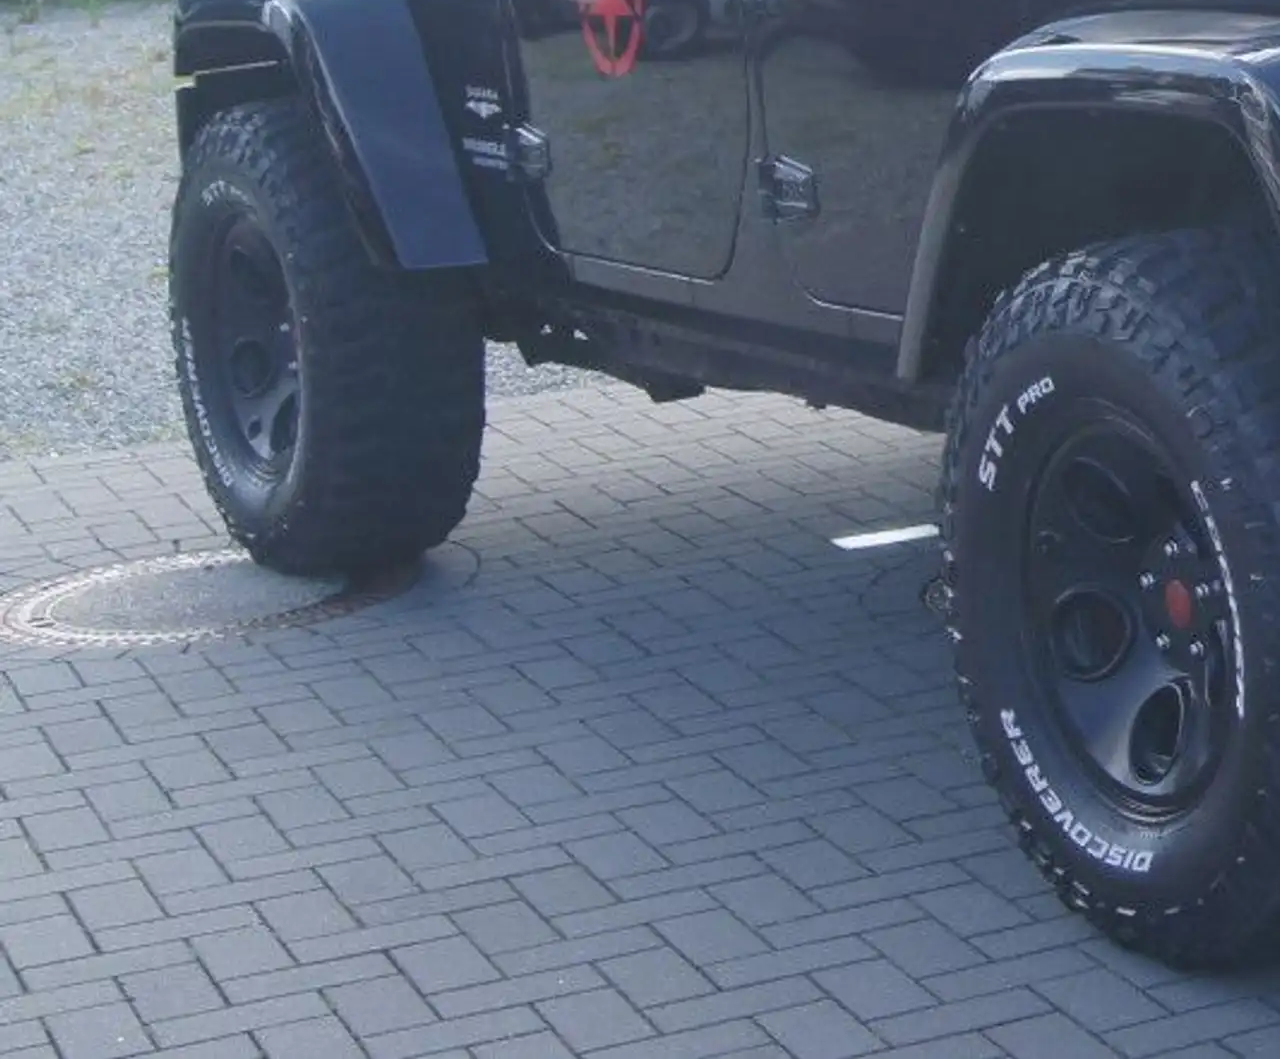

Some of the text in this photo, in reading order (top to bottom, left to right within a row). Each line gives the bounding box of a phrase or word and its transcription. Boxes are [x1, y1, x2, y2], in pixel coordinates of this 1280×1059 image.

[978, 375, 1055, 491] STT PRO
[1000, 707, 1155, 874] DISCOVERER
